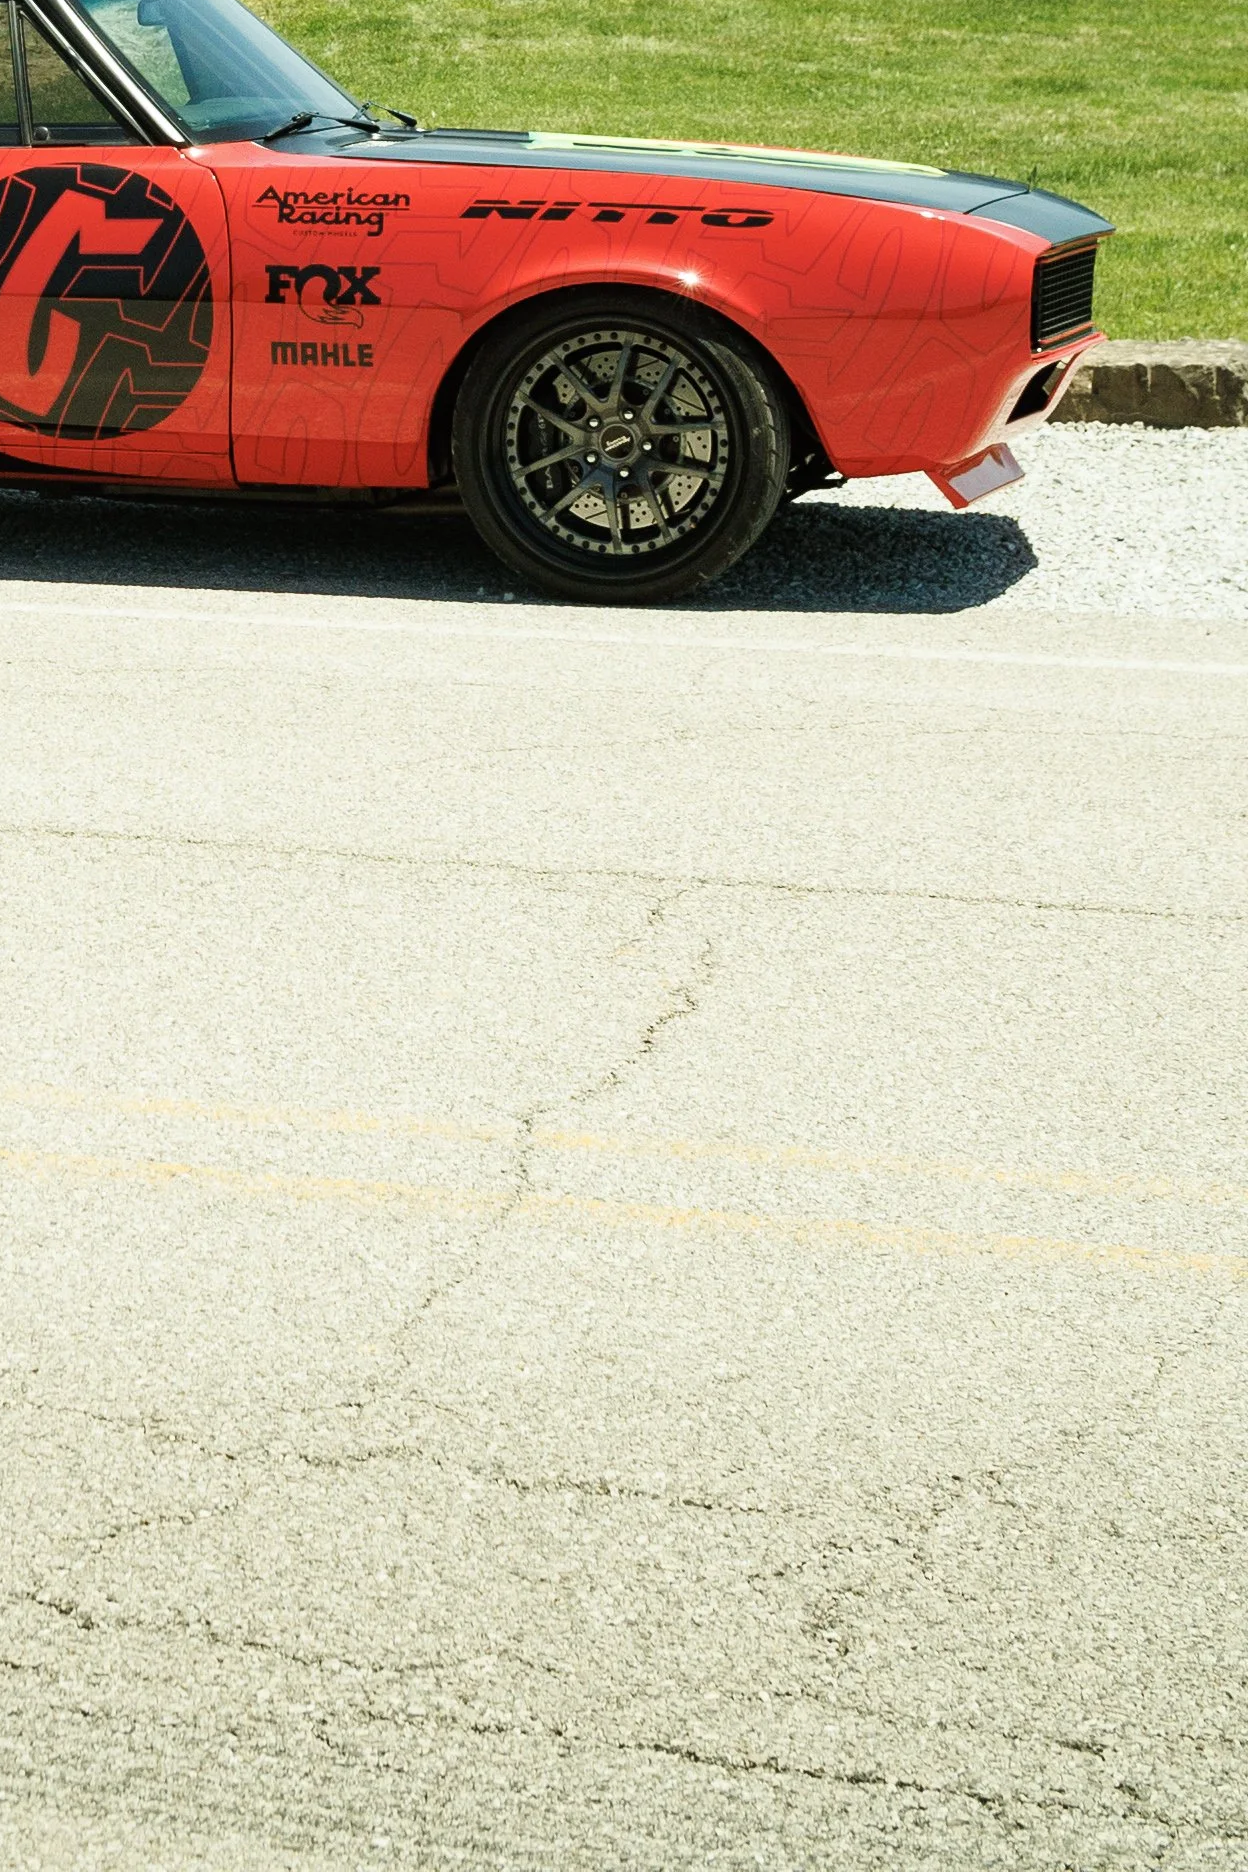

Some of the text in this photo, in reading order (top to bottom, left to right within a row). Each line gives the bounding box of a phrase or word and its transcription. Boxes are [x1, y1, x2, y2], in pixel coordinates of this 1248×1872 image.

[255, 185, 411, 206] American
[277, 203, 385, 237] Racing
[459, 200, 775, 228] NITTO
[264, 264, 382, 328] FOX
[271, 341, 374, 367] MAHLE
